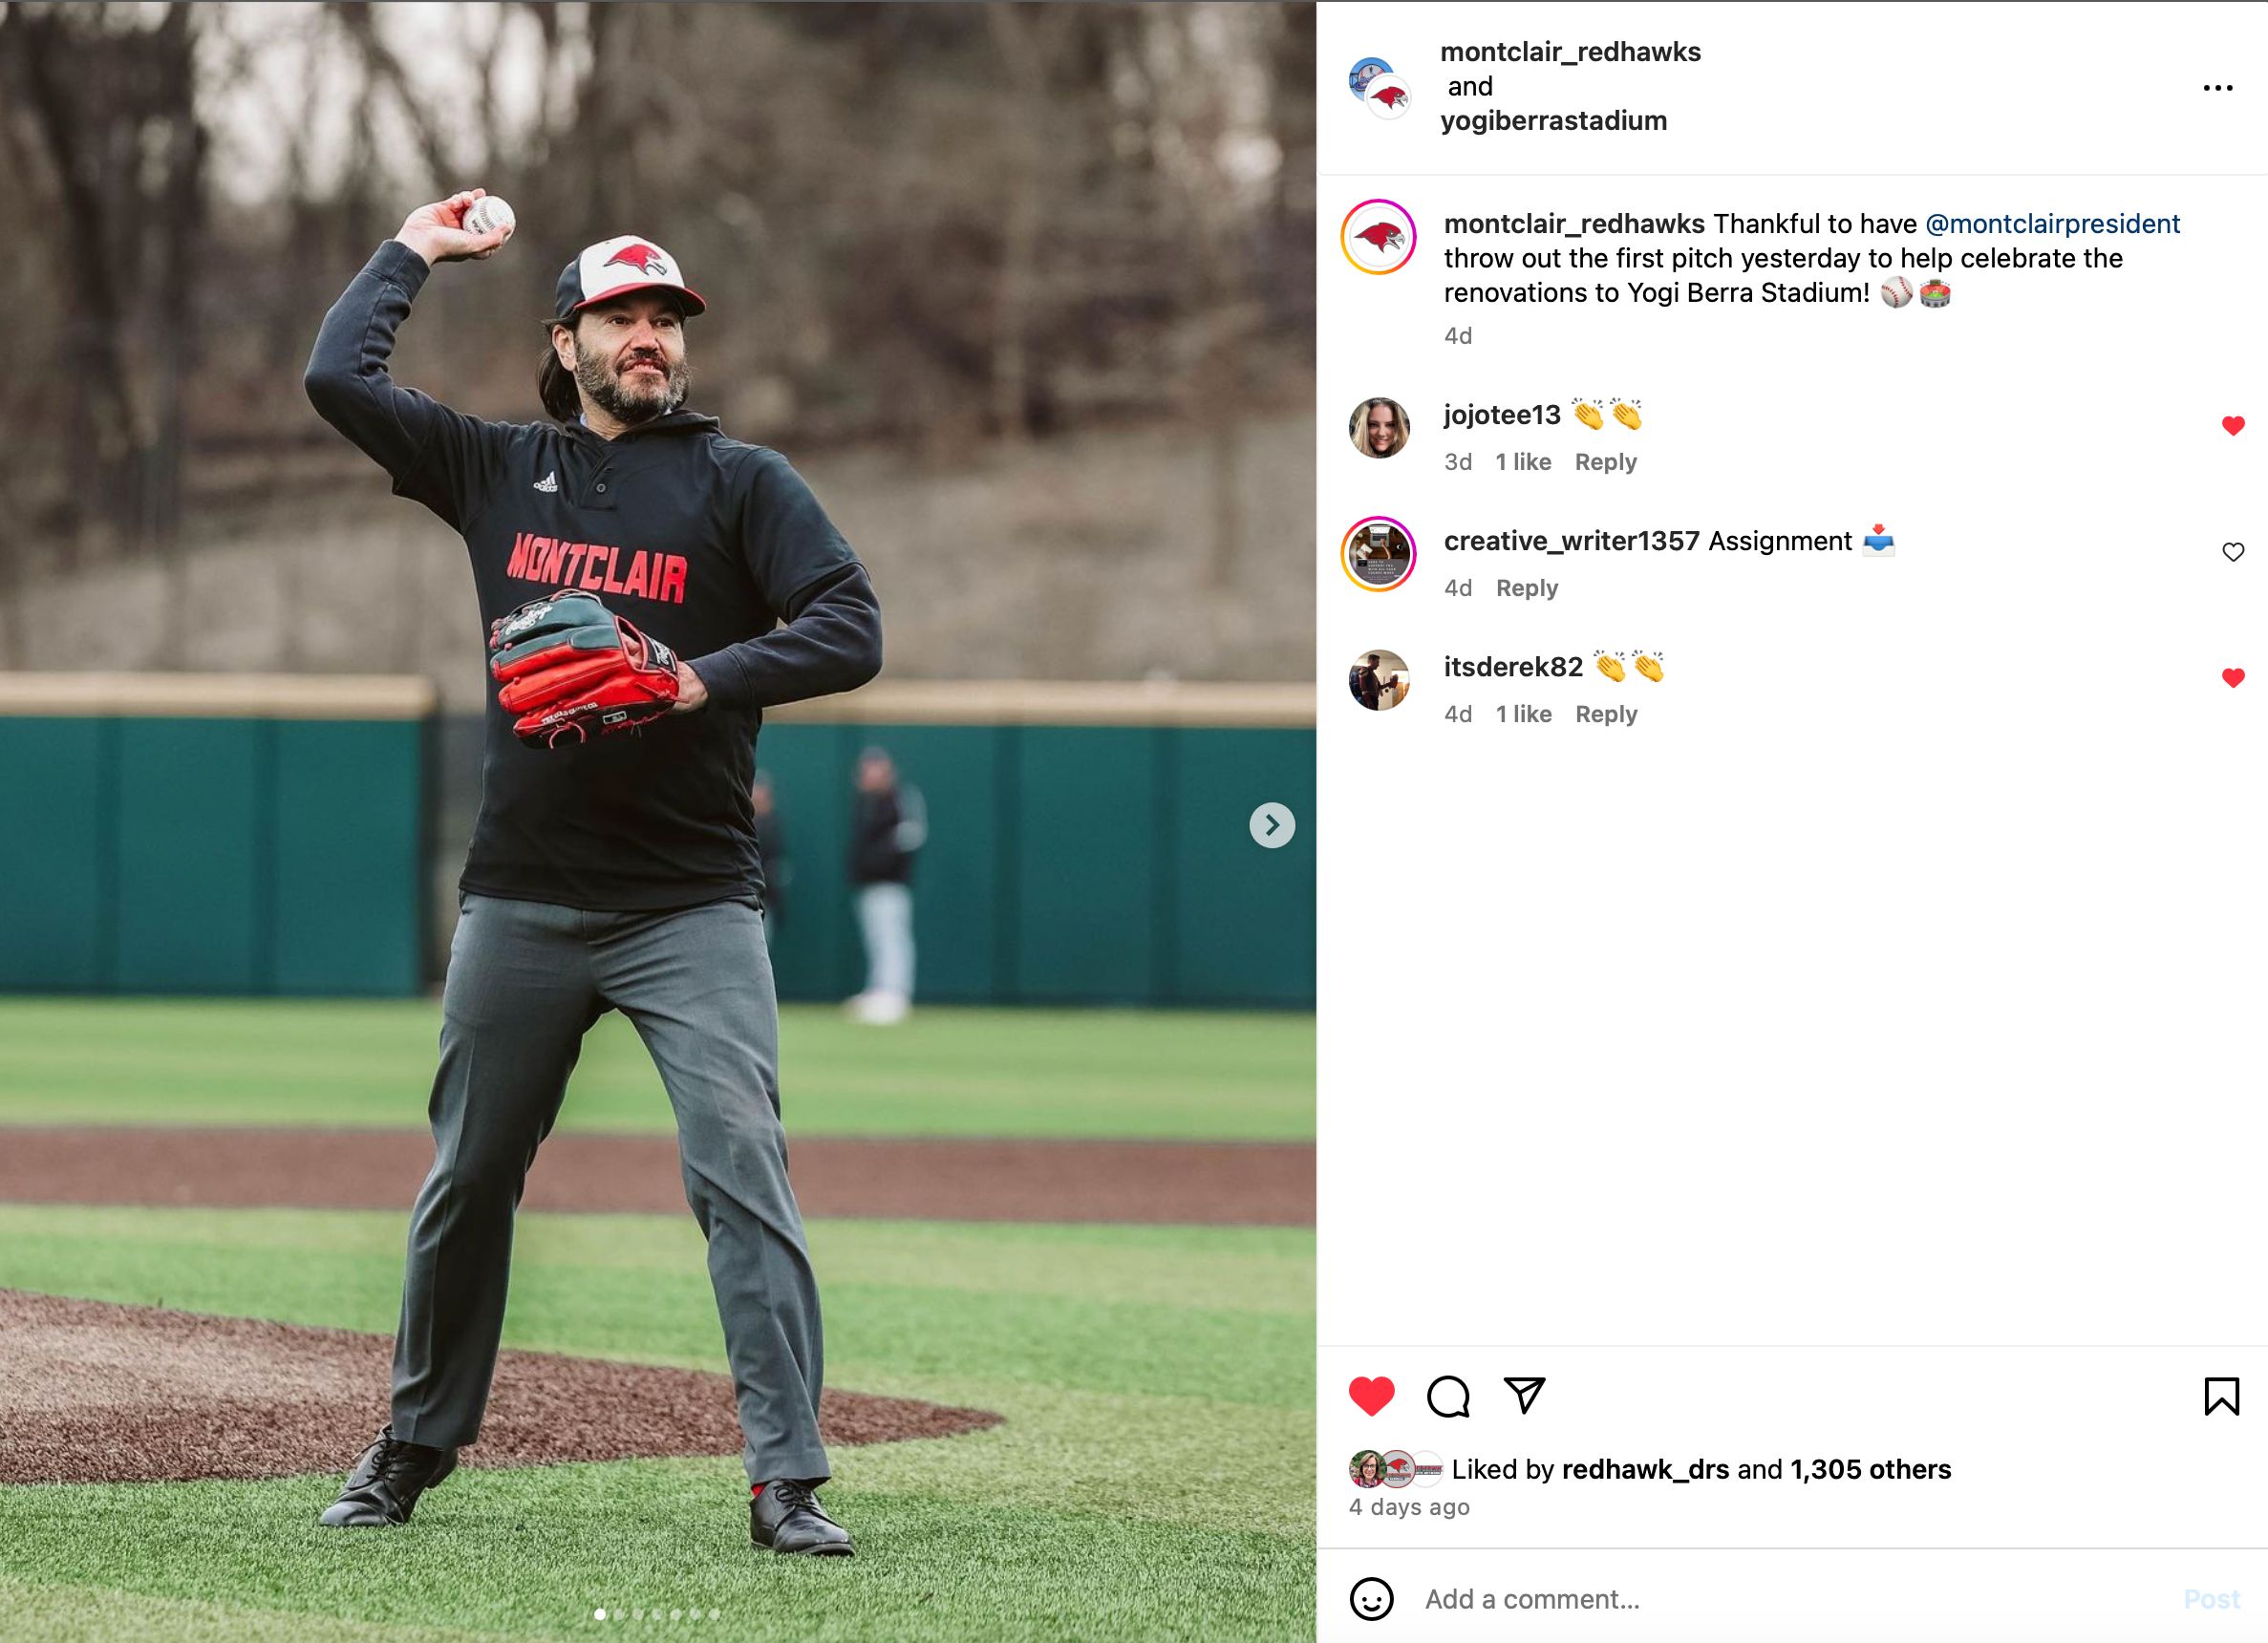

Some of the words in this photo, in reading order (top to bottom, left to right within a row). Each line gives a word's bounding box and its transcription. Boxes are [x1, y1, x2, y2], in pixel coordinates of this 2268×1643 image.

[1441, 39, 1702, 67] montclair_redhawks
[1447, 75, 1493, 97] and
[1440, 108, 1668, 137] yogiberrastadium
[1444, 211, 1706, 239] montclair_redhawks
[1713, 212, 1820, 235] Thankful
[1827, 214, 1853, 235] to
[1860, 212, 1918, 235] have
[1925, 212, 2181, 239] @montclairpresident
[1444, 246, 1515, 269] throw
[1521, 248, 1562, 269] out
[1568, 246, 1609, 269] the
[1615, 245, 1664, 269] first
[1672, 246, 1733, 273] pitch
[1740, 246, 1862, 274] yesterday
[1868, 248, 1894, 269] to
[1901, 246, 1954, 273] help
[1960, 246, 2077, 269] celebrate
[2083, 246, 2124, 269] the
[1444, 281, 1588, 304] renovations
[1594, 283, 1620, 304] to
[1627, 281, 1680, 308] Yogi
[1687, 282, 1753, 304] Berra
[1761, 281, 1870, 304] Stadium!
[1444, 326, 1472, 345] 4d
[1443, 402, 1562, 430] jojotee13
[1444, 452, 1472, 472] 3d
[1495, 452, 1506, 471] 1
[1513, 451, 1552, 471] like
[1575, 452, 1638, 476] Reply
[1444, 528, 1701, 556] creative_writer1357
[1708, 529, 1853, 556] Assignment
[506, 532, 688, 604] MONTCLAIR
[1444, 578, 1472, 597] 4d
[1497, 578, 1560, 602] Reply
[1444, 654, 1584, 678] itsderek82
[1444, 704, 1472, 723] 4d
[1496, 704, 1506, 723] 1
[1513, 703, 1552, 723] like
[1576, 704, 1639, 728] Reply
[1452, 1458, 1517, 1481] Liked
[1526, 1458, 1555, 1485] by
[1562, 1458, 1730, 1484] redhawk_drs
[1737, 1458, 1783, 1481] and
[1790, 1458, 1862, 1485] 1,305
[1869, 1458, 1953, 1481] others
[1348, 1497, 1363, 1516] 4
[1370, 1497, 1423, 1521] days
[1429, 1501, 1470, 1521] ago
[1424, 1588, 1474, 1611] Add
[1482, 1592, 1496, 1610] a
[2185, 1589, 2241, 1611] Post
